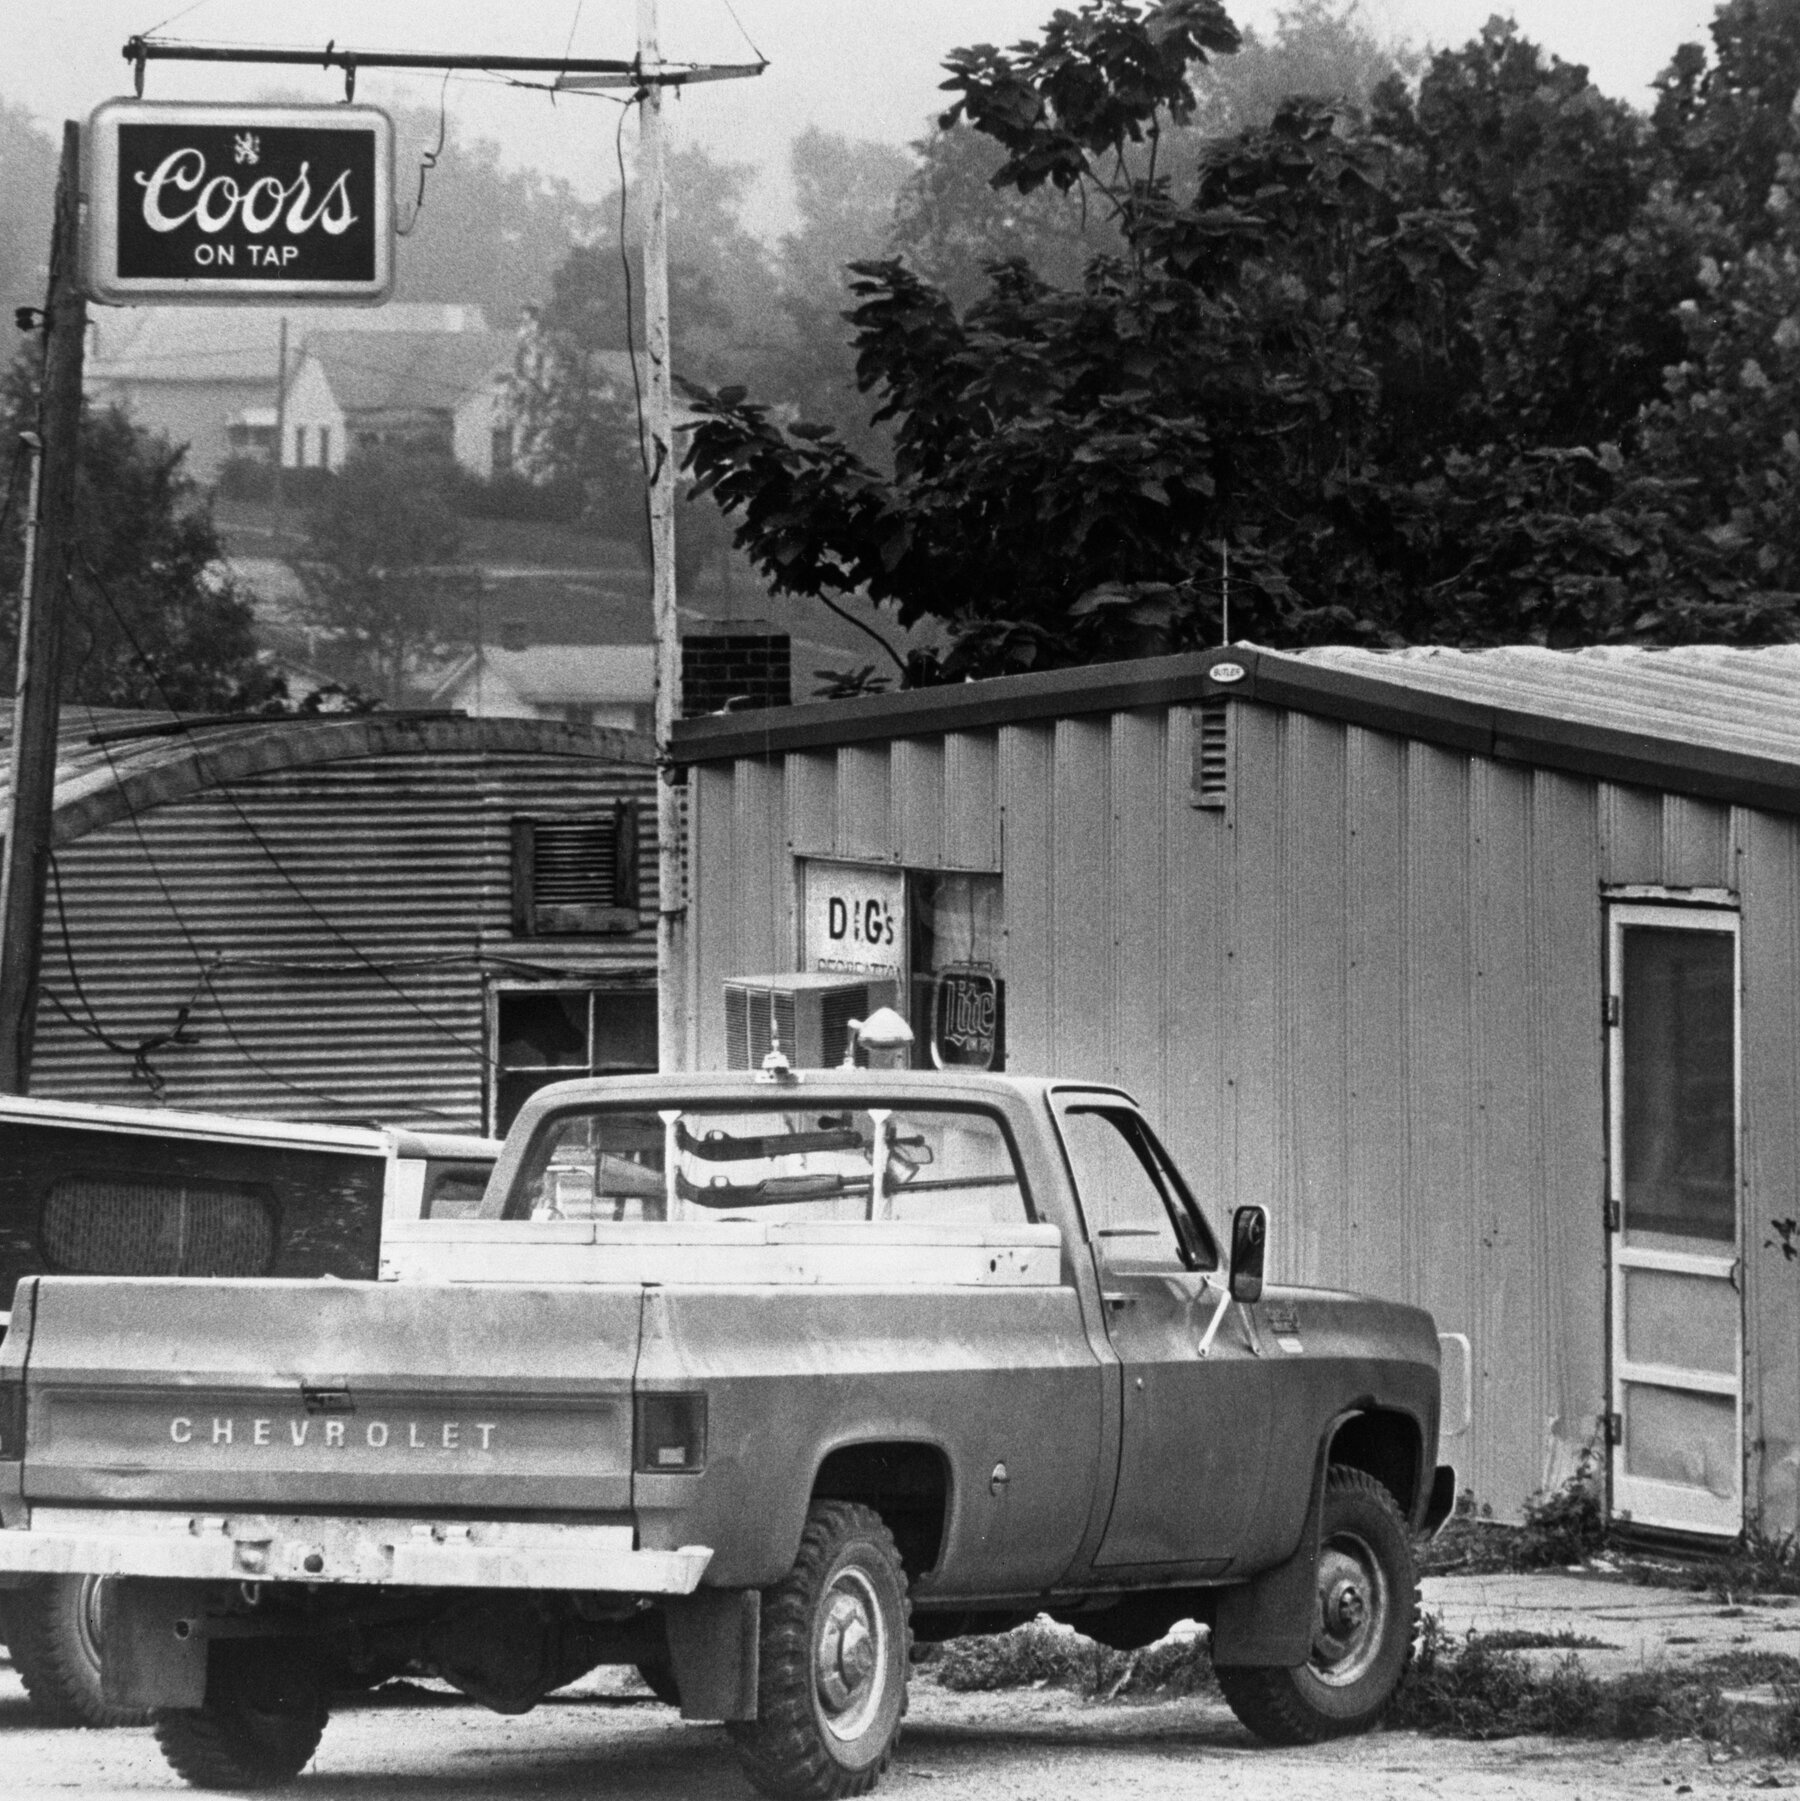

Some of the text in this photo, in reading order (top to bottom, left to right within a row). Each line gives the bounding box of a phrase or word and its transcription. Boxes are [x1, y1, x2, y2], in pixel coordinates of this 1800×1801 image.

[134, 148, 359, 235] Coors
[194, 244, 299, 267] ON TAP
[169, 1417, 497, 1449] CHEVROLET
